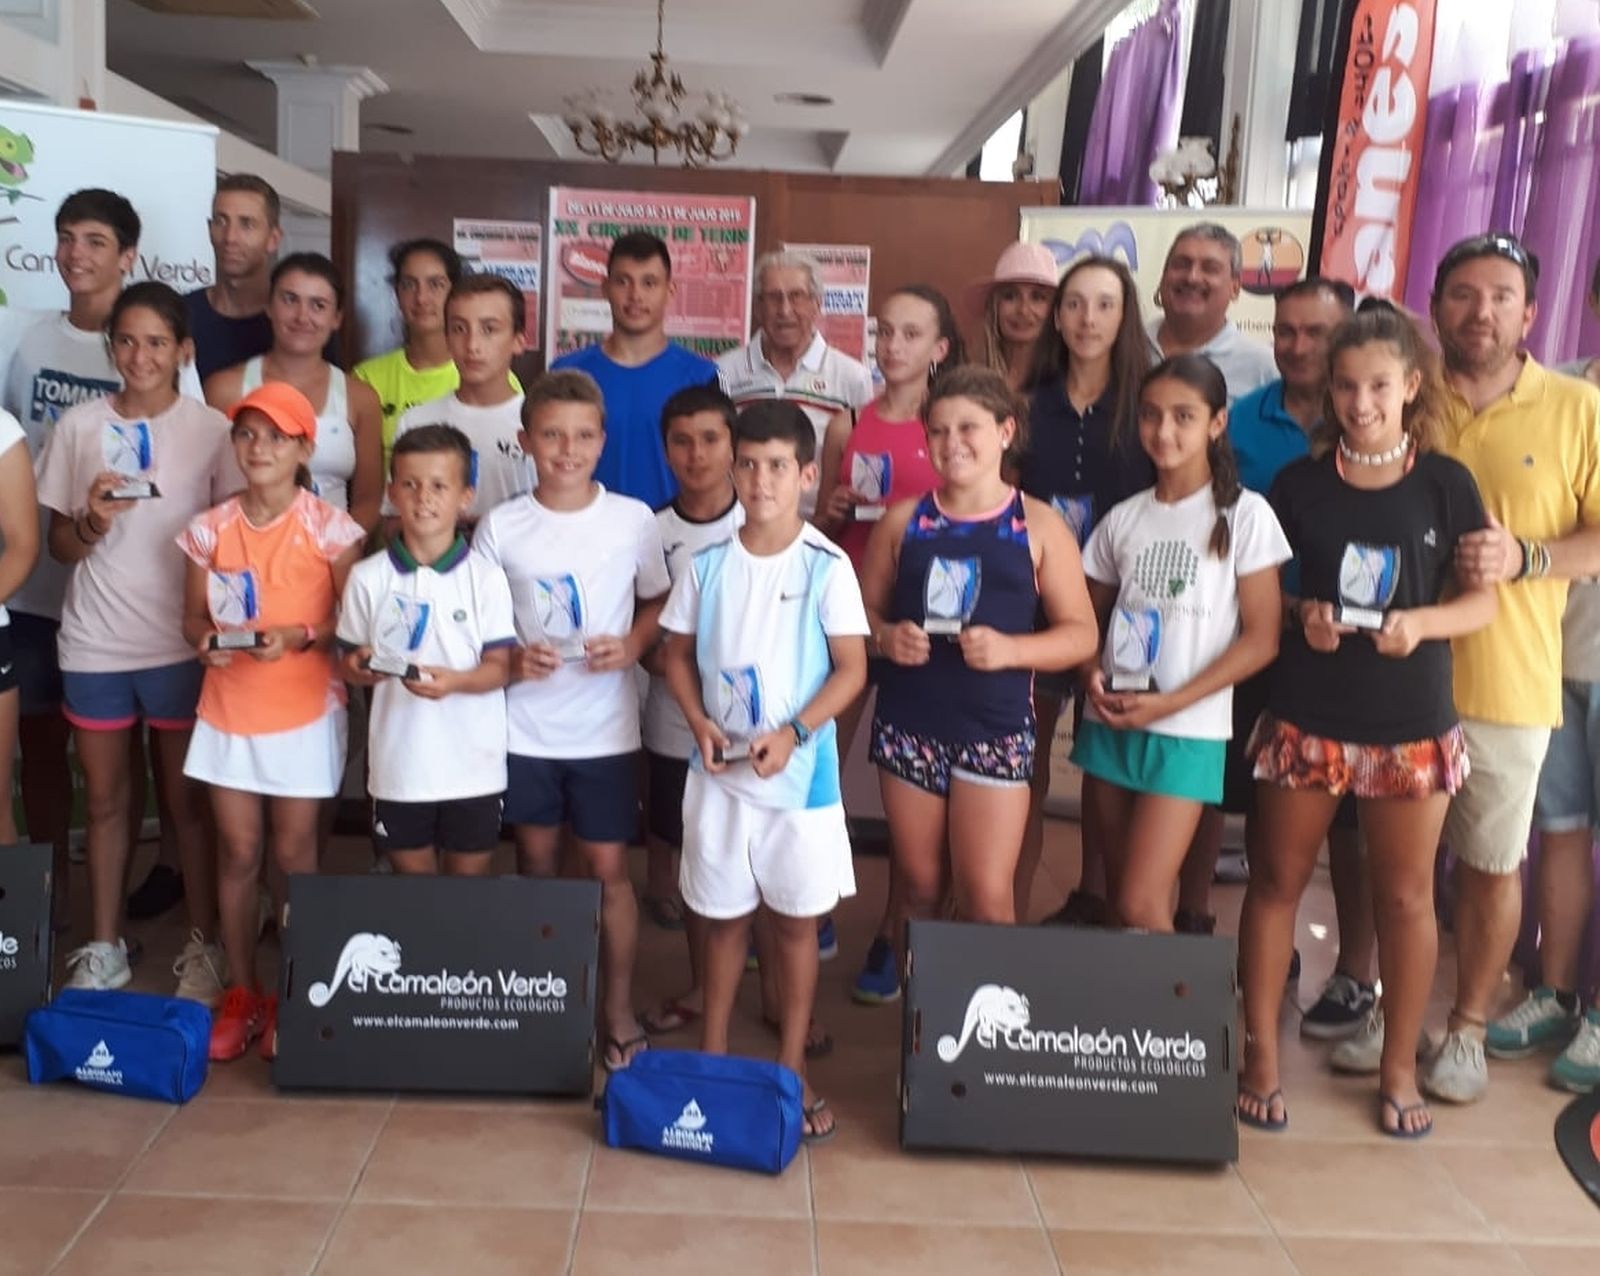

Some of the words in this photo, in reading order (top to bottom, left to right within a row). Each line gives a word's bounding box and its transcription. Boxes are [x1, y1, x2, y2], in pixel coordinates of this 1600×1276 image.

[140, 254, 211, 285] Verde
[498, 969, 567, 998] Verde
[440, 996, 500, 1011] PRODUCTOS
[352, 1014, 519, 1031] www.elcamaleonverde.com
[1132, 1028, 1206, 1061] Verde
[1074, 1056, 1136, 1073] PRODUCTOS
[983, 1071, 1159, 1094] www.elcamaleonverde.com
